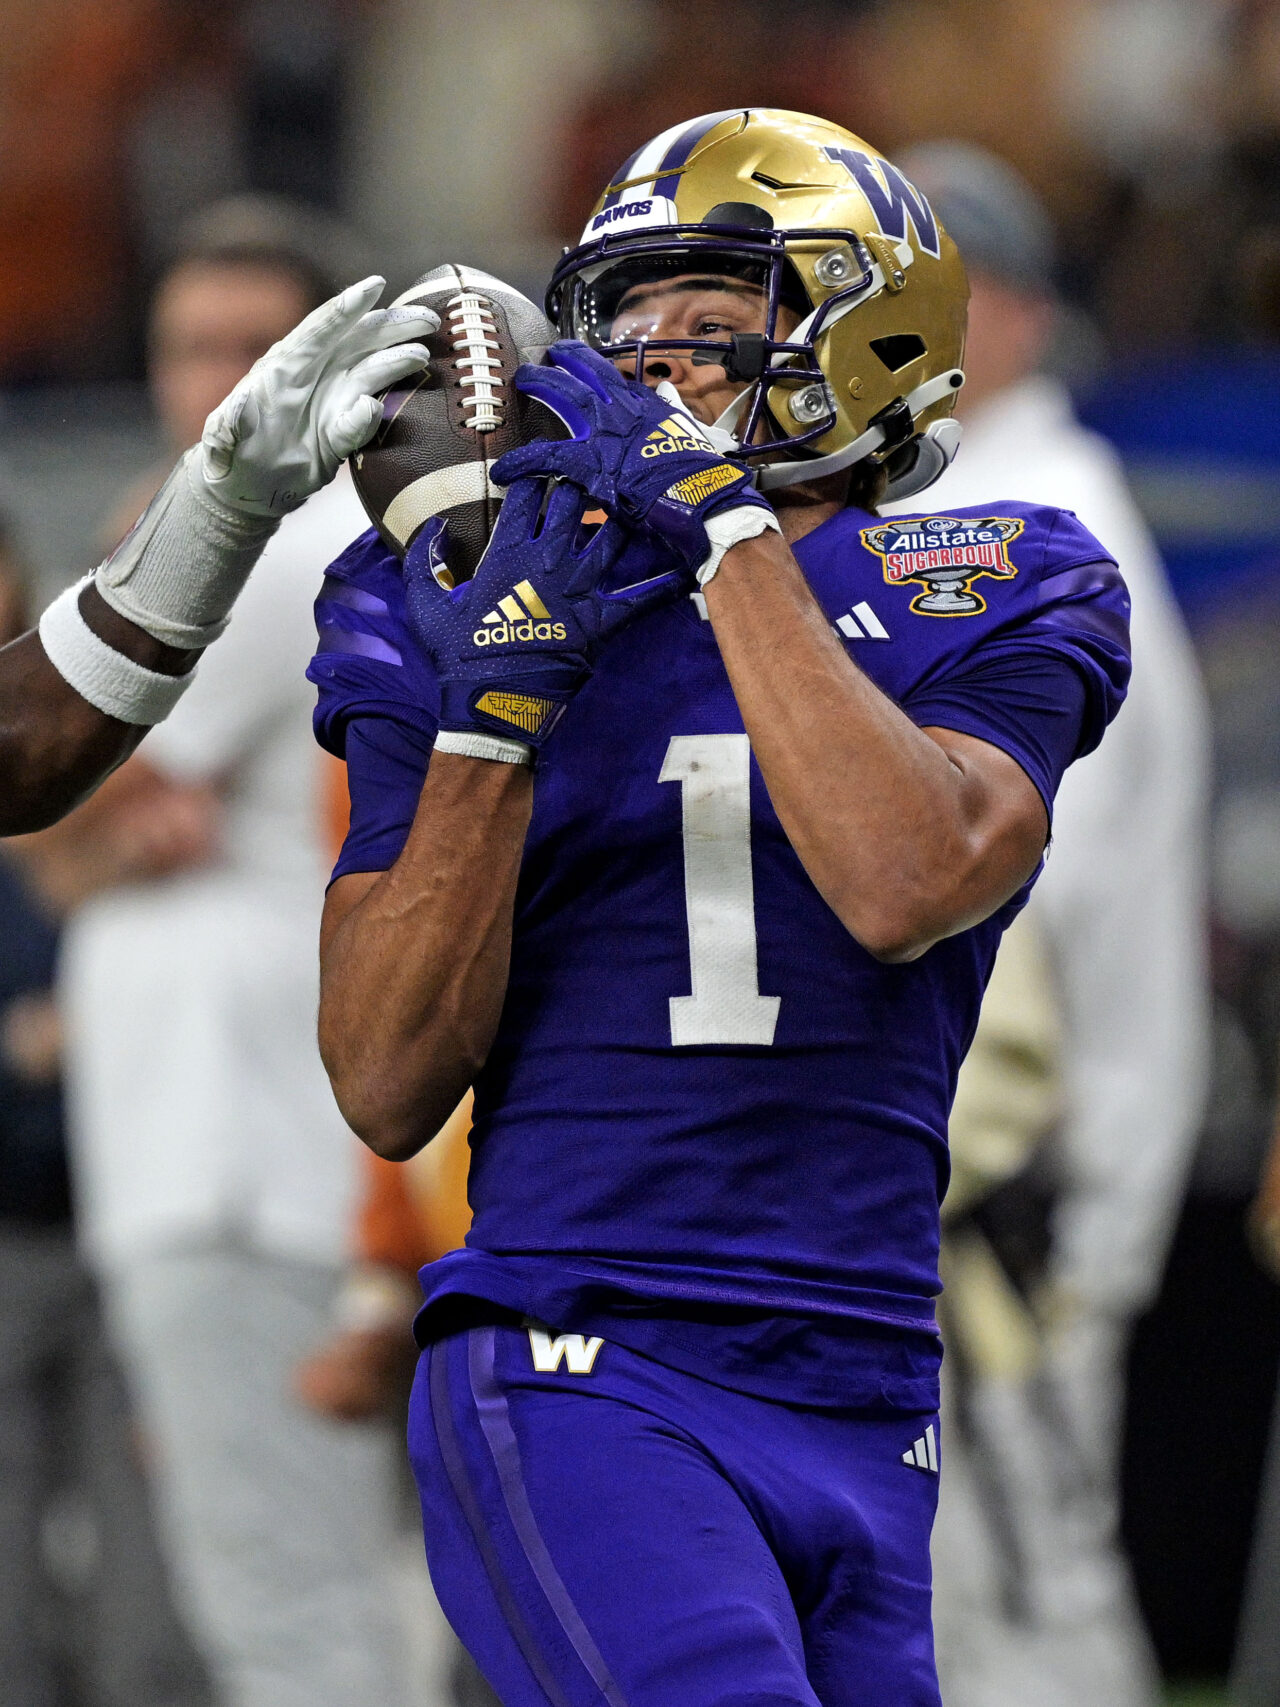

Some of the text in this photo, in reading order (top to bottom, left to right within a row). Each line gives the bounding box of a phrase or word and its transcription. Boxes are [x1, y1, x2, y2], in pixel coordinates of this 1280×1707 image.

[592, 200, 653, 231] DAWGS
[822, 146, 941, 260] W
[890, 531, 992, 551] Allstate
[473, 619, 567, 647] adidas
[658, 734, 781, 1046] 1
